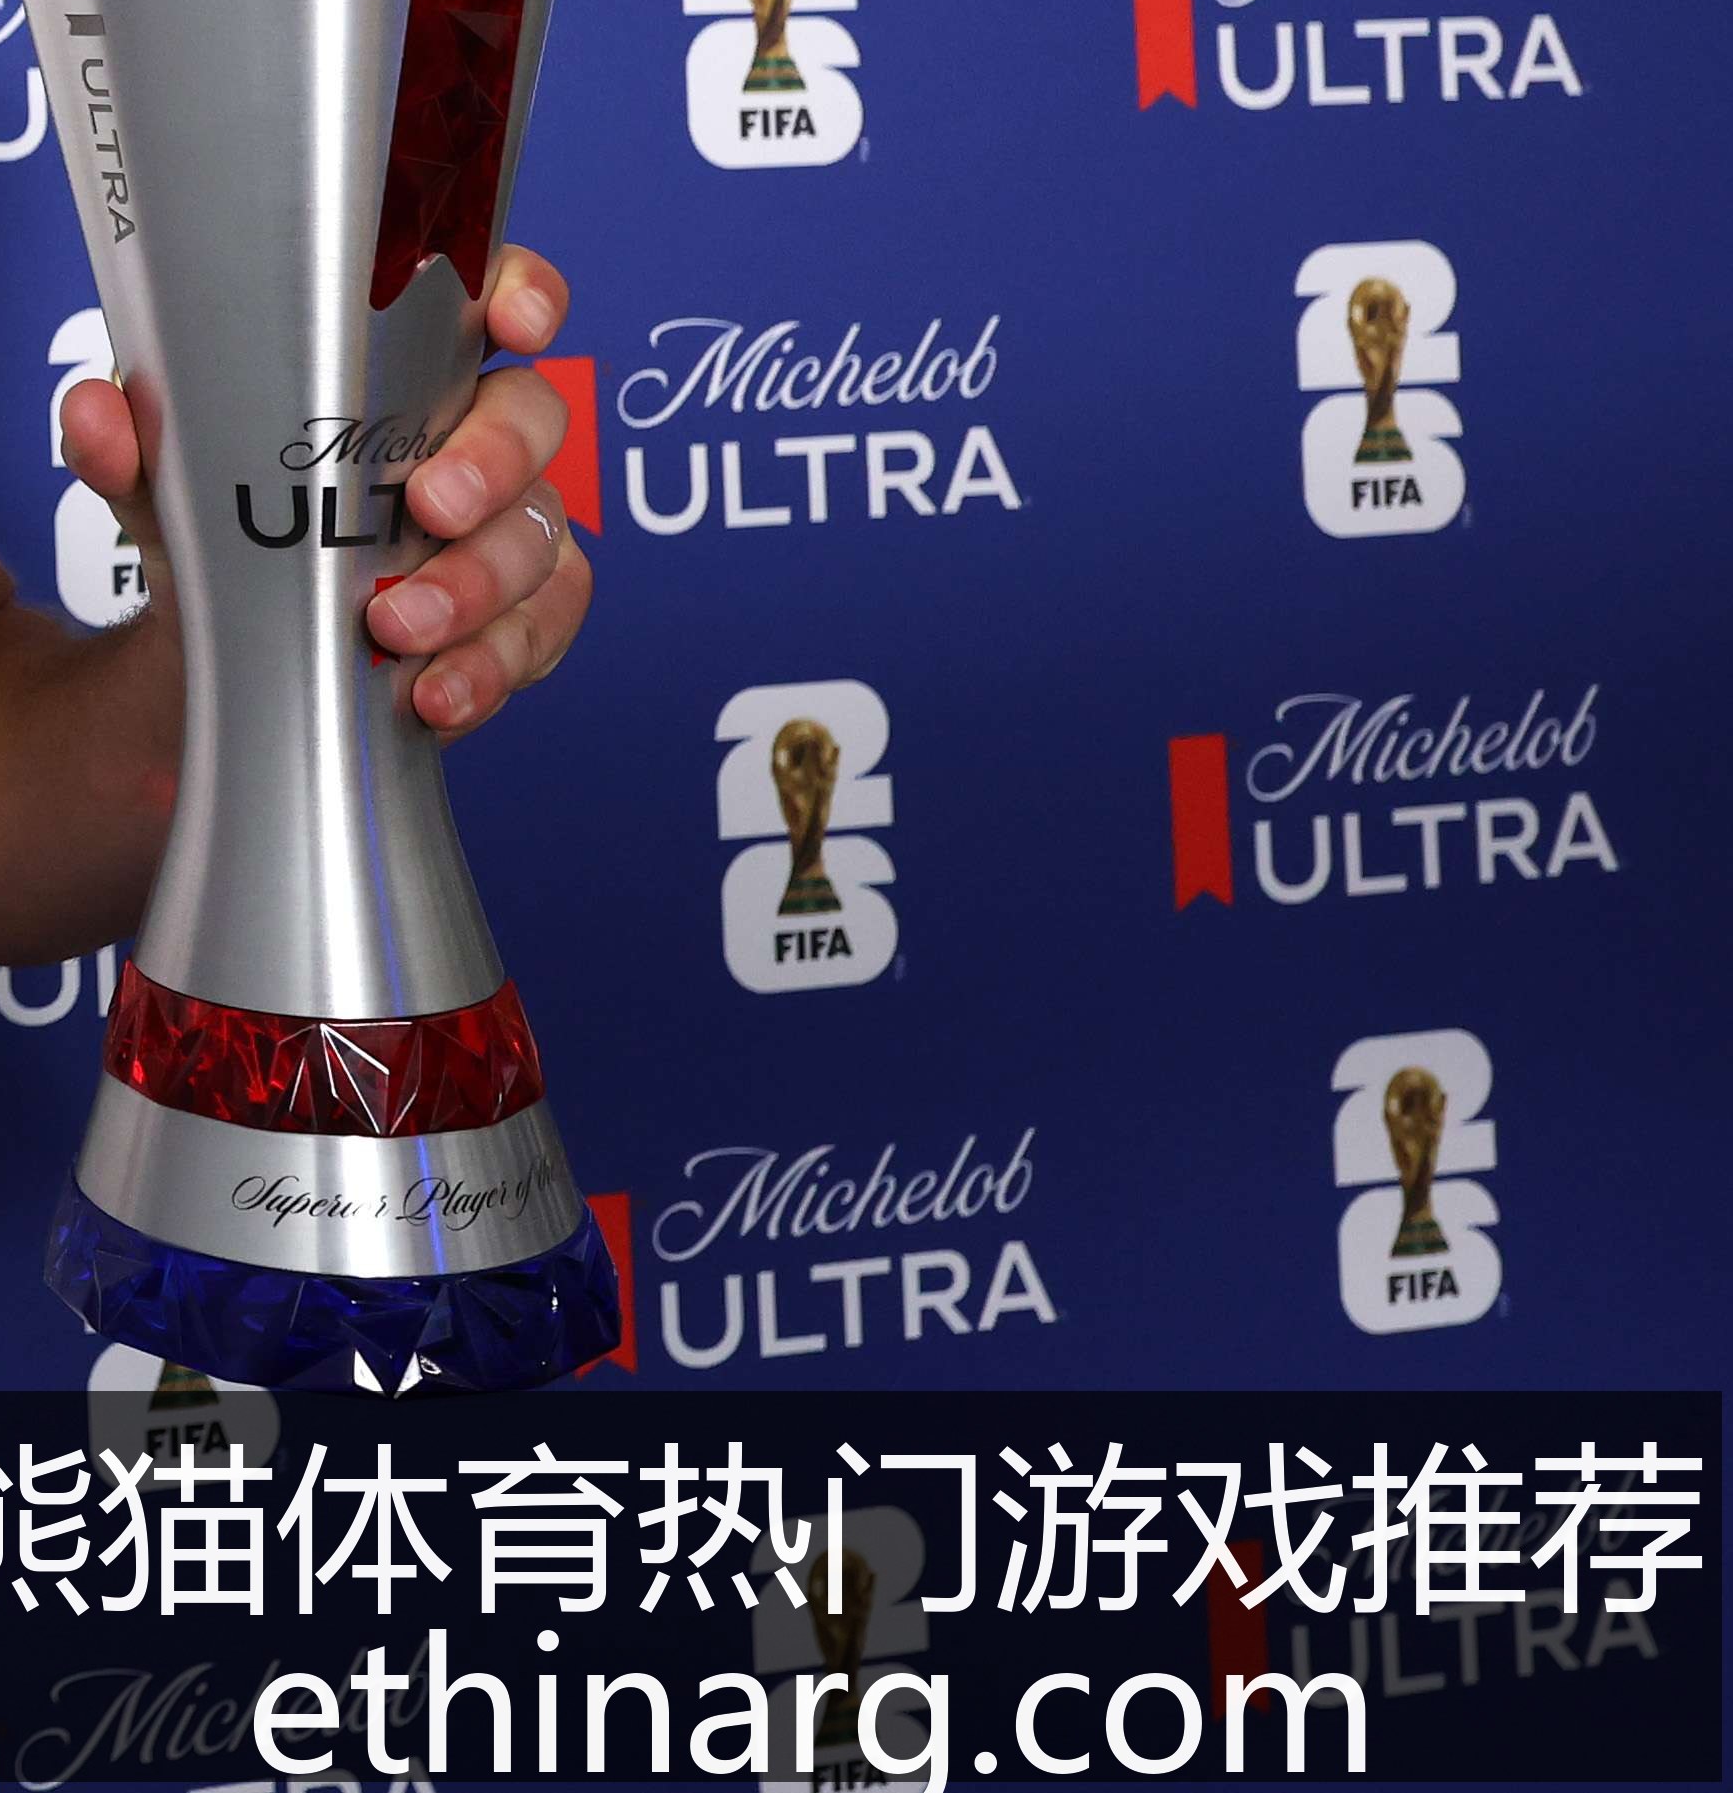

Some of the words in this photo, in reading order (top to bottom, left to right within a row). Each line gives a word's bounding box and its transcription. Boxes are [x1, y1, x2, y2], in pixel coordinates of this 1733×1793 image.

[1216, 14, 1583, 111] ULTRA
[80, 58, 136, 245] ULTRA
[740, 108, 816, 138] FIFA
[617, 314, 1000, 429] Michelob
[279, 416, 448, 472] Miche
[624, 425, 1022, 536] ULTRA
[235, 483, 409, 550] ULT
[1351, 477, 1422, 508] FIFA
[112, 563, 147, 596] FI
[1246, 684, 1598, 803] Michelob
[1254, 791, 1619, 905] ULTRA
[774, 927, 853, 964] FIFA
[395, 1175, 507, 1230] Player
[652, 1127, 1035, 1262] Michelob
[660, 1240, 1058, 1369] ULTRA
[1388, 1269, 1458, 1303] FIFA
